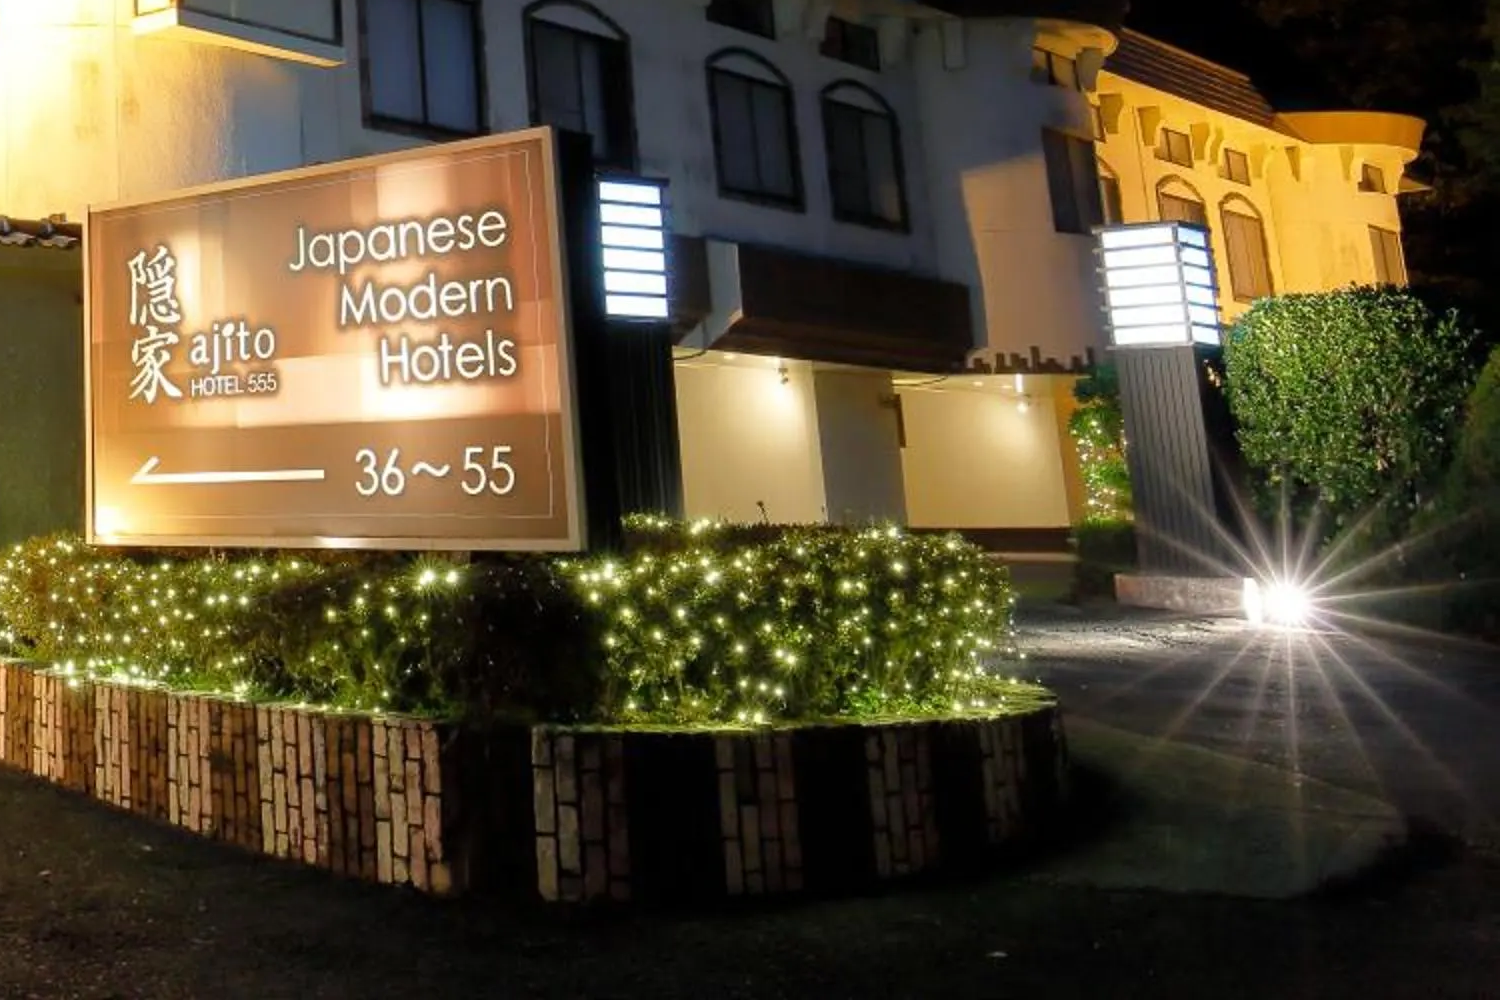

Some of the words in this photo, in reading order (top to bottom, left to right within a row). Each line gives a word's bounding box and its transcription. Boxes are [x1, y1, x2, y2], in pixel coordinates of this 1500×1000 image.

[289, 209, 507, 275] Japanese
[339, 273, 513, 326] Modern
[191, 322, 275, 375] ajito
[380, 328, 518, 384] Hotels
[190, 376, 243, 396] HOTEL
[247, 373, 278, 393] 555
